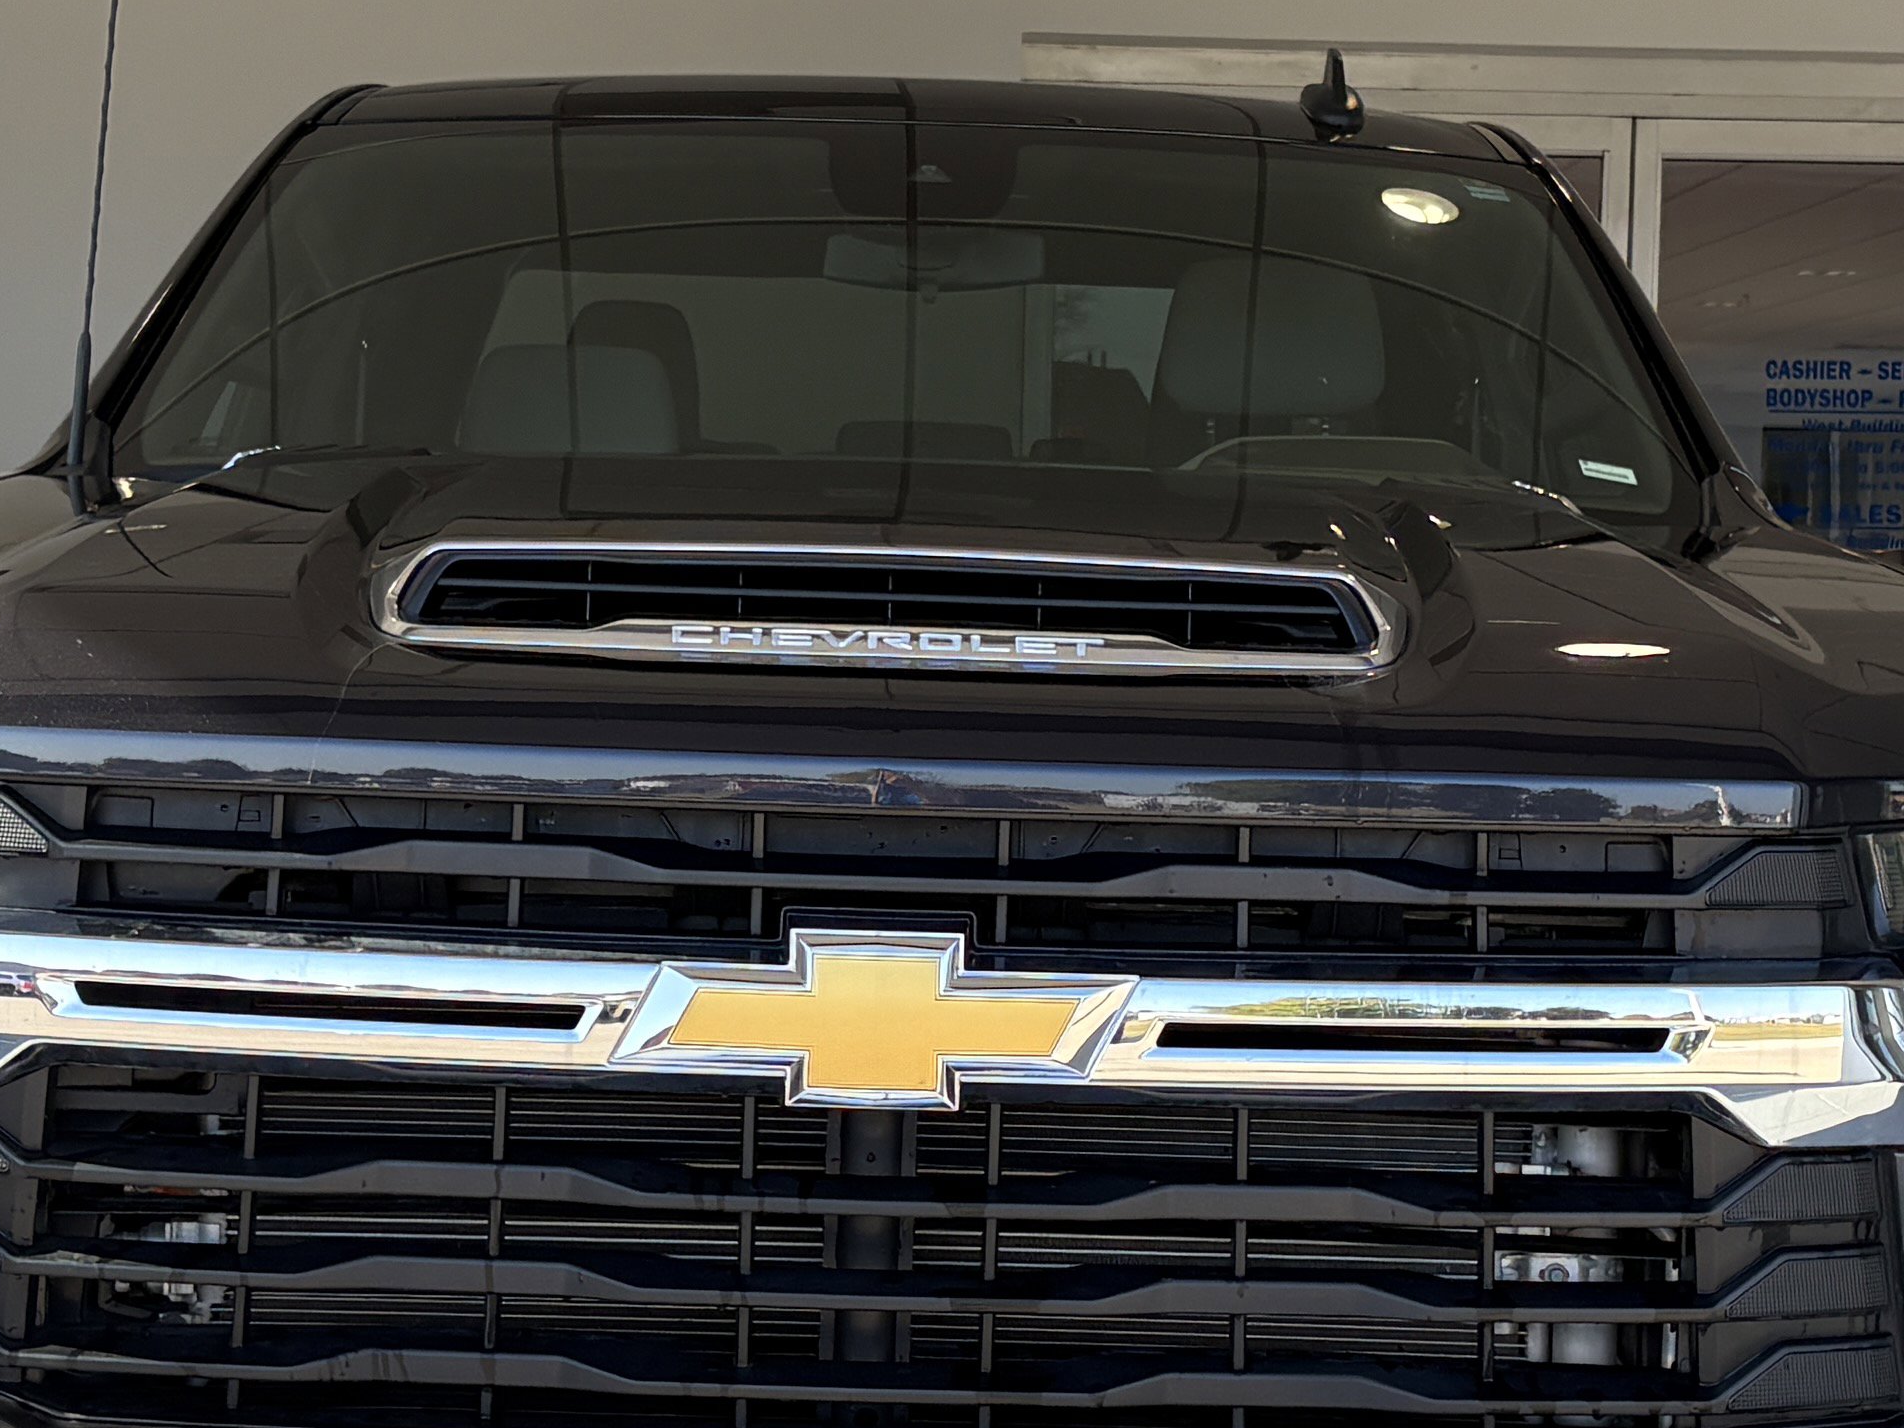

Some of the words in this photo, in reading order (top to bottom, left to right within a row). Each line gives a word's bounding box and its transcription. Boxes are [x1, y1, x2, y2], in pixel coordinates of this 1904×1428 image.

[1765, 359, 1852, 380] CASHIER
[1766, 388, 1874, 408] BODYSHOP
[671, 625, 1105, 658] CHEVROLET
